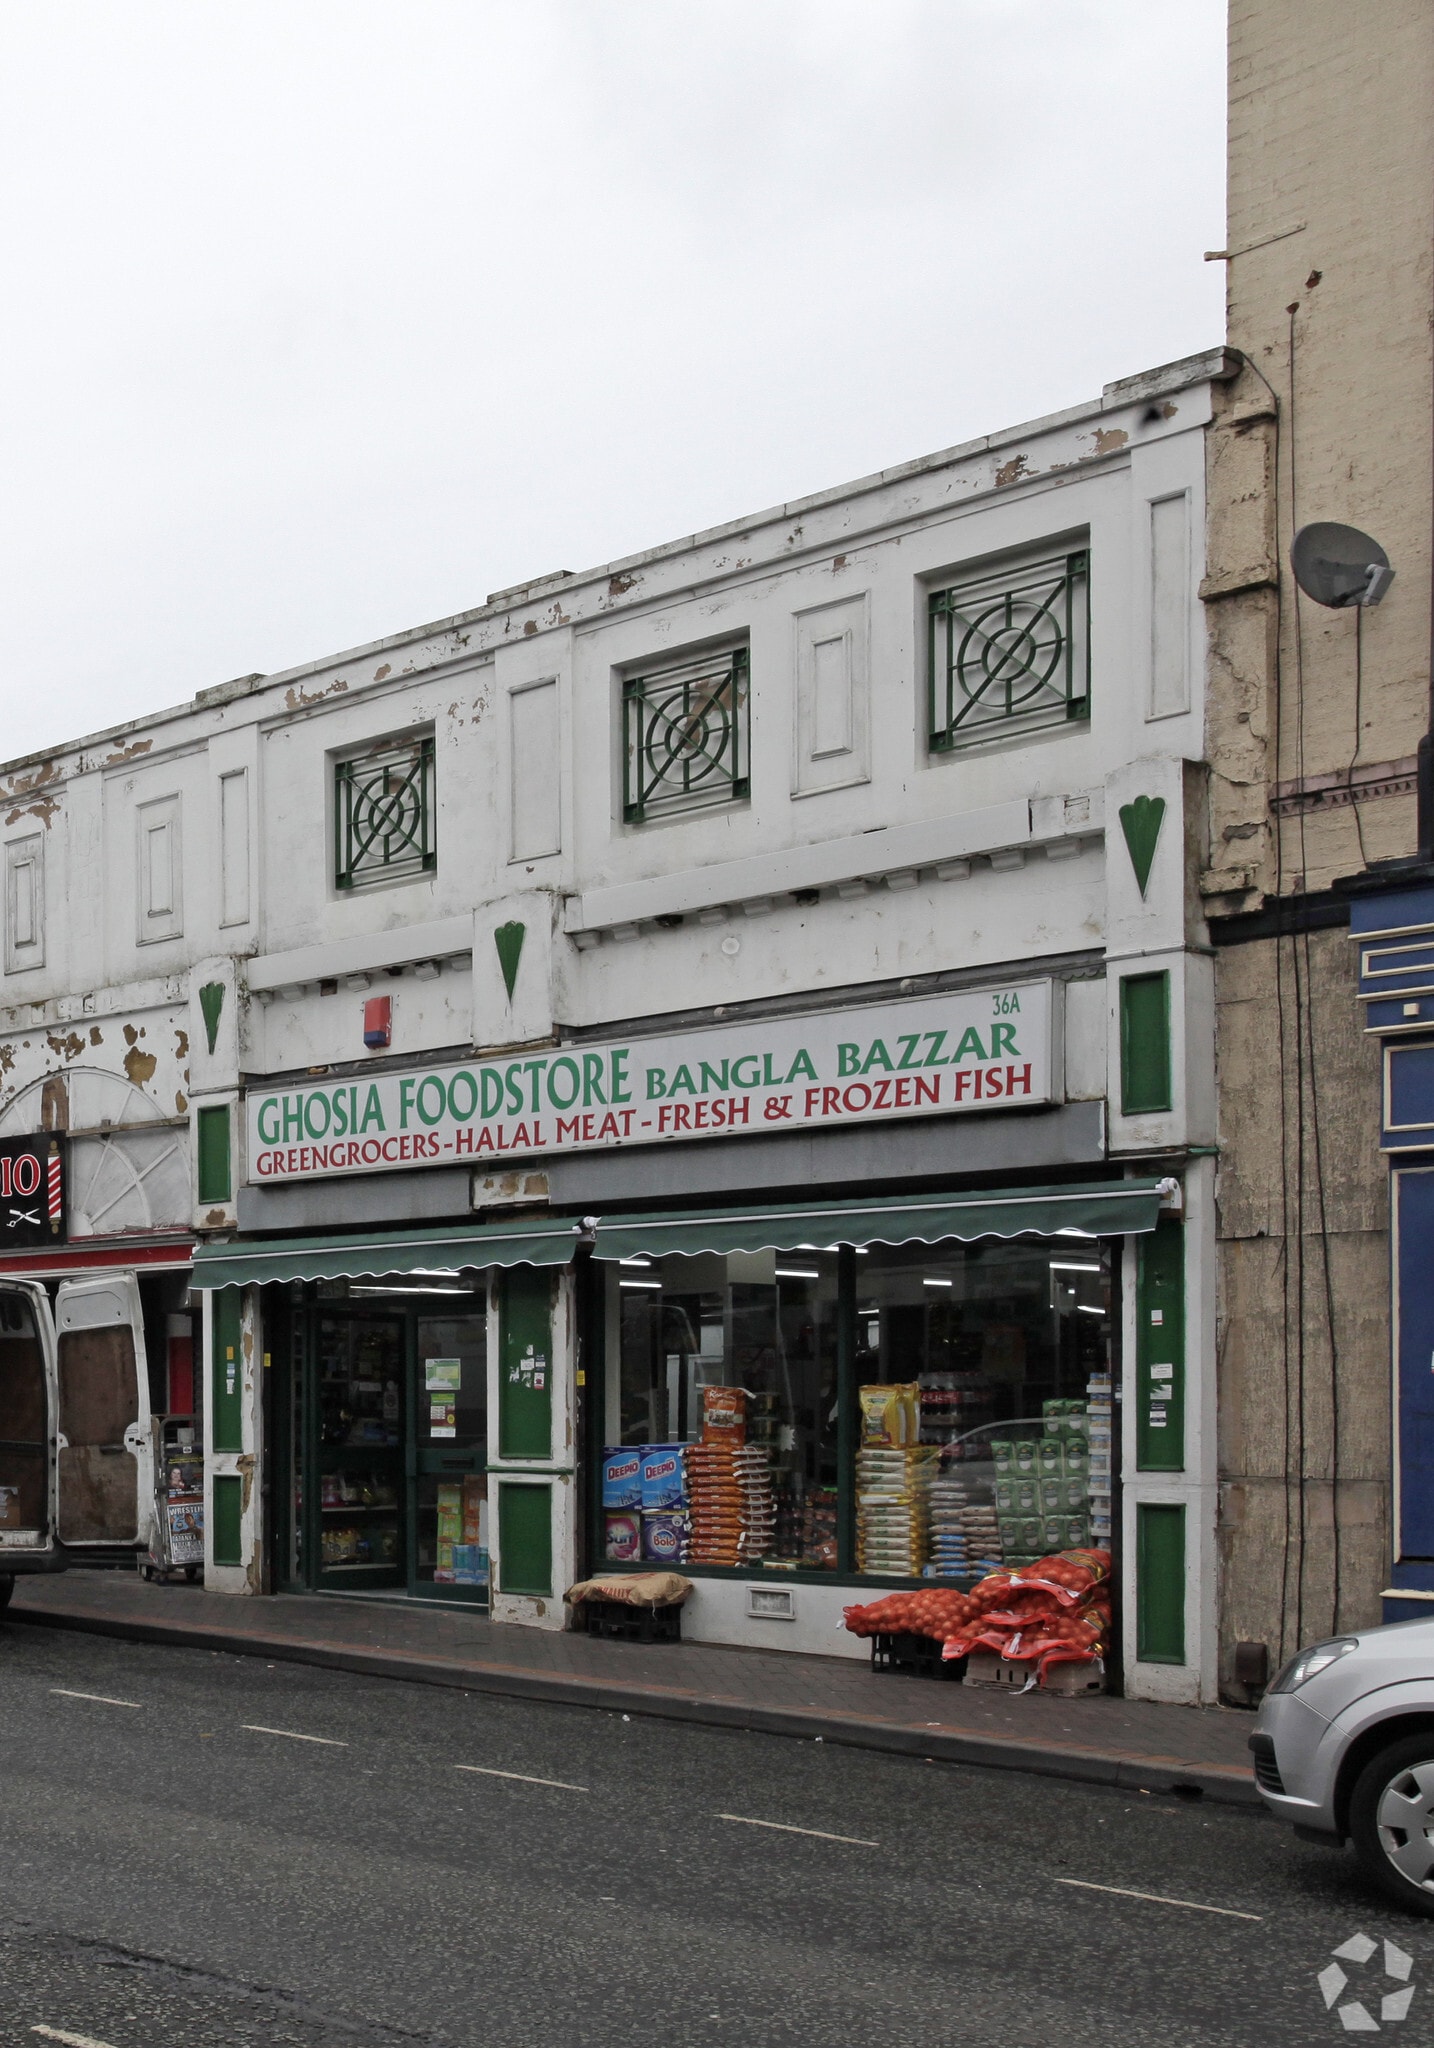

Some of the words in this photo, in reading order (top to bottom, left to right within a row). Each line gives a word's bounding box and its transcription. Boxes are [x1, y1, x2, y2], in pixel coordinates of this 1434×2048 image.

[992, 995, 1021, 1016] 36A
[257, 1084, 387, 1146] GHOSIA
[399, 1048, 633, 1129] FOODSTORE
[646, 1048, 818, 1101] BANGLA
[837, 1022, 1022, 1078] BAZZAR
[763, 1095, 793, 1121] &
[804, 1074, 941, 1117] FROZEN
[954, 1063, 1033, 1102] FISH
[607, 1530, 634, 1544] Surf
[653, 1535, 676, 1546] Bold
